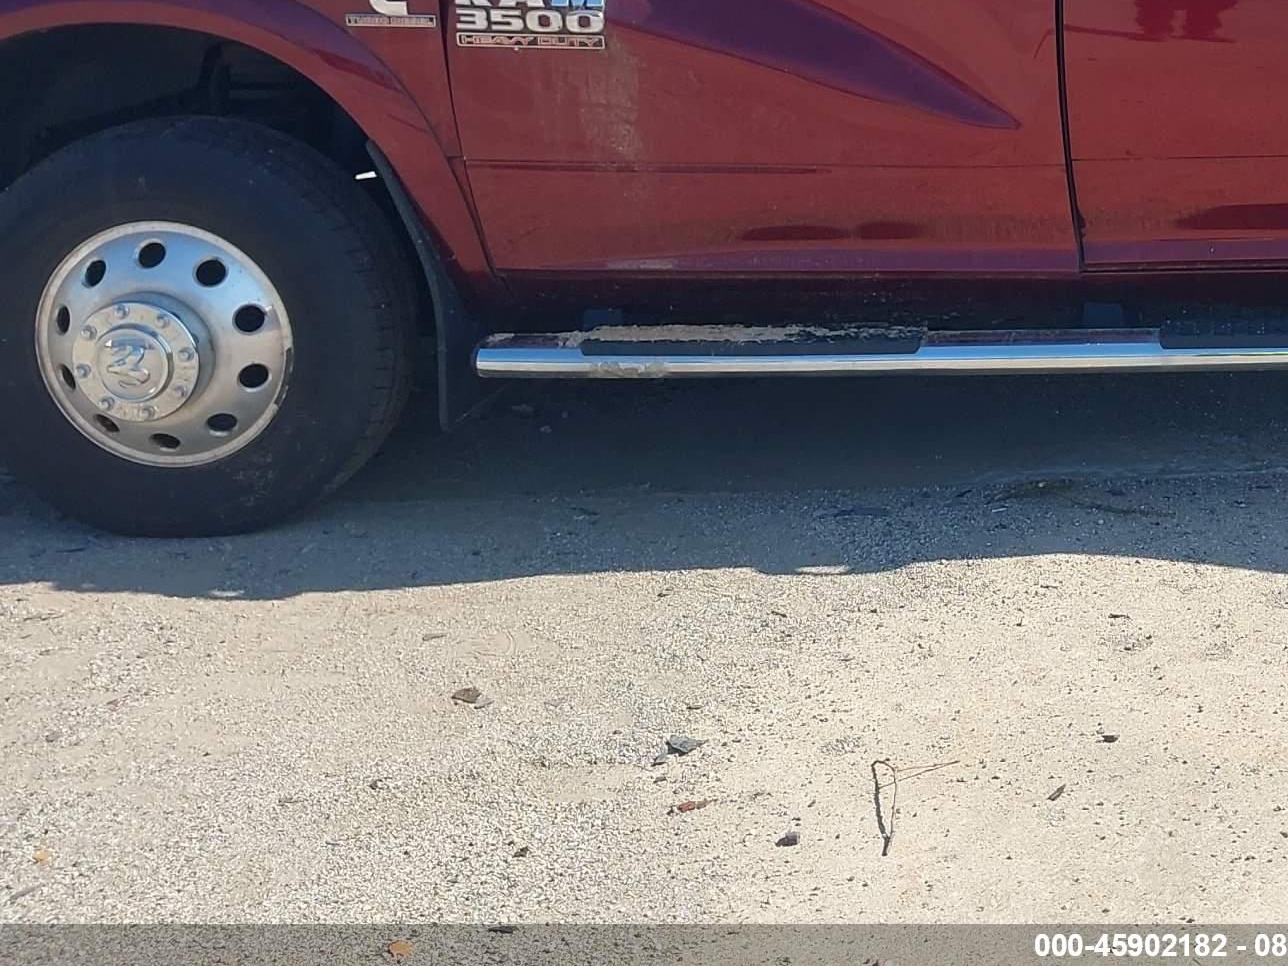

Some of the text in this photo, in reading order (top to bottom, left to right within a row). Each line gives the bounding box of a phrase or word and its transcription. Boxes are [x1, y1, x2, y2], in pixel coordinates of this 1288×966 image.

[455, 8, 605, 33] 3500
[460, 35, 600, 48] HEAVY DUTY
